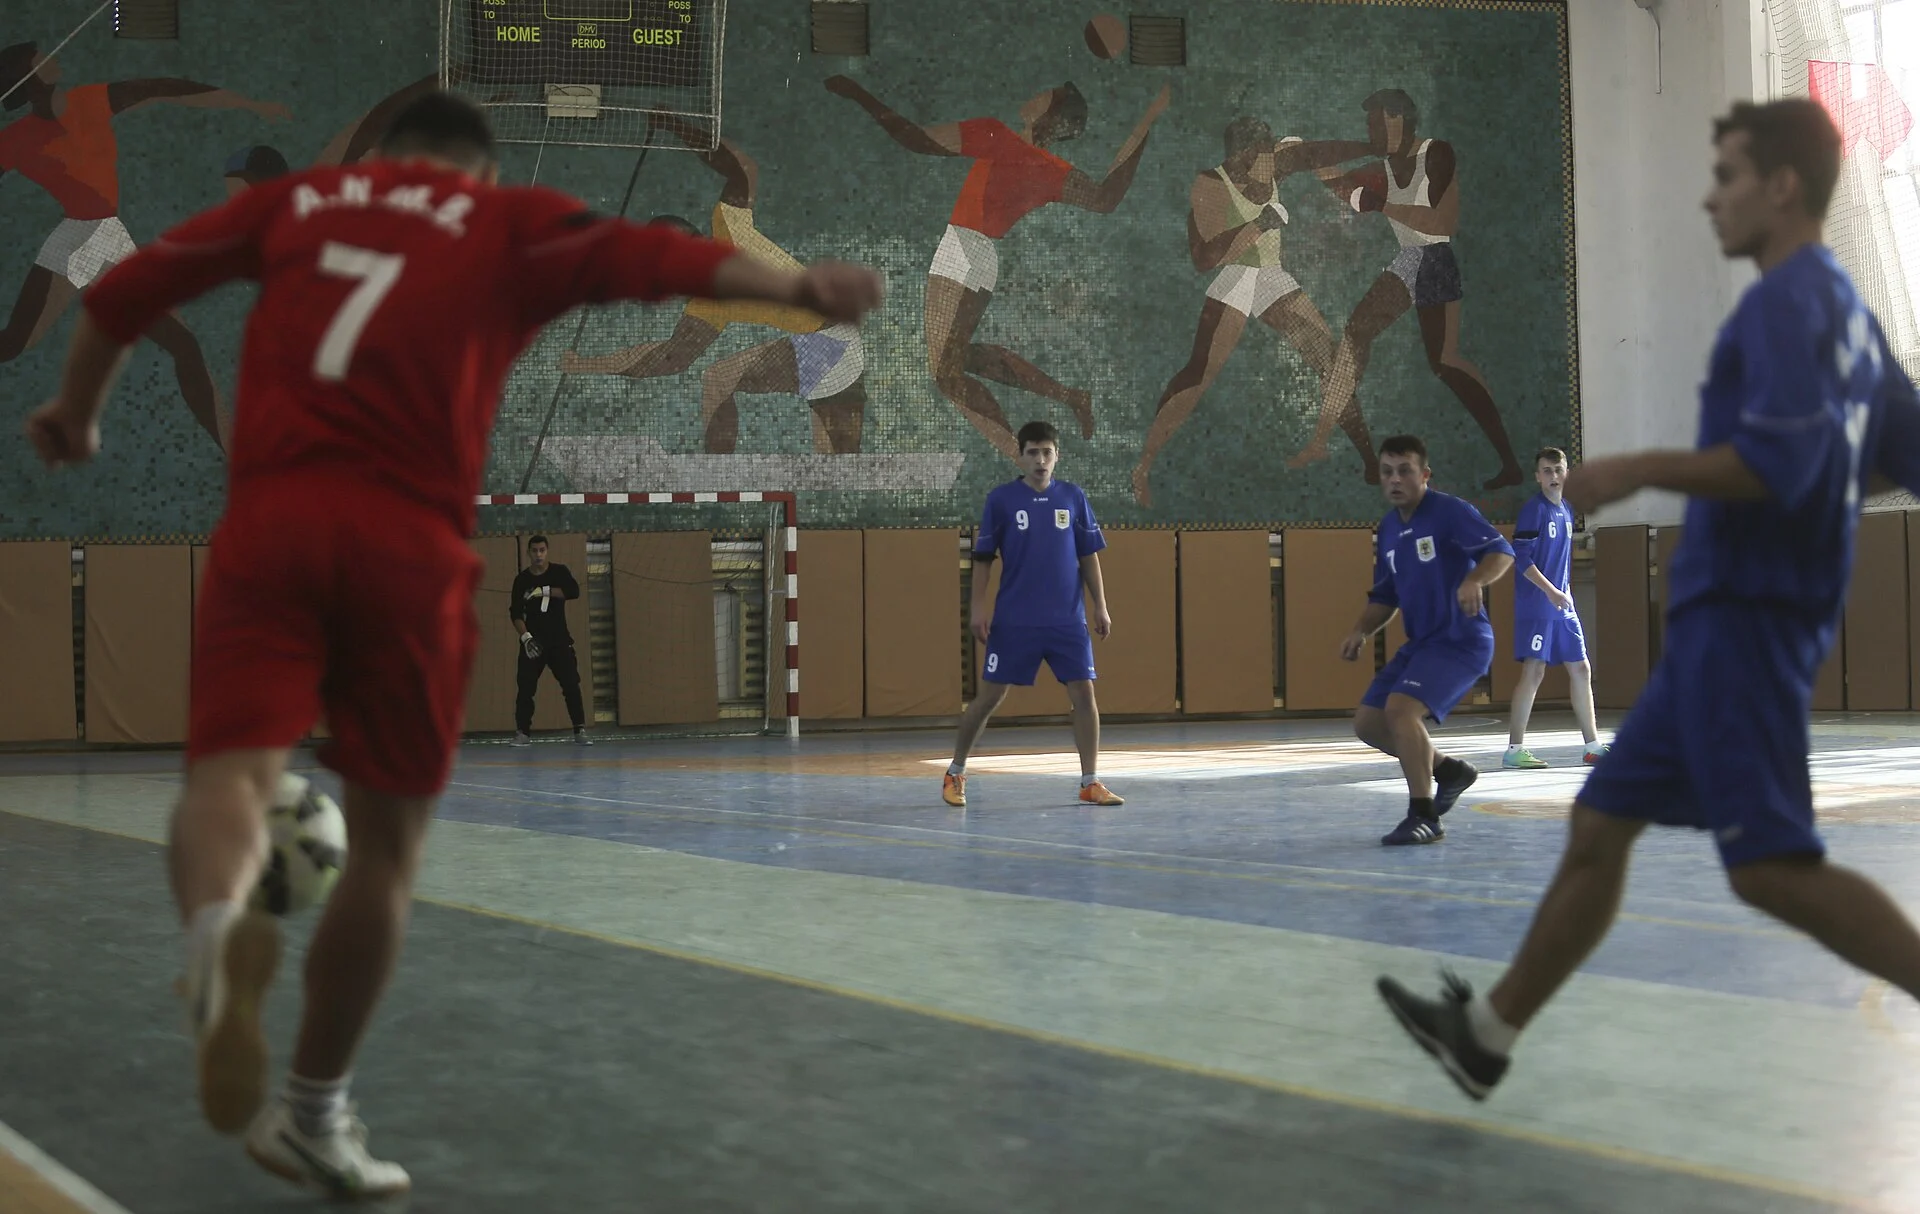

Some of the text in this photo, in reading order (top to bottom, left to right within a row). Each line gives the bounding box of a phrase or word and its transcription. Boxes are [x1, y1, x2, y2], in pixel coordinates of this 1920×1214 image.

[668, 1, 691, 10] POSS
[483, 10, 496, 19] TO
[679, 14, 691, 23] TO
[497, 26, 541, 42] HOME
[633, 28, 683, 45] GUEST
[571, 38, 606, 49] PERIOD
[313, 240, 407, 384] 7
[1016, 509, 1030, 531] 9
[1548, 520, 1557, 539] 6
[1386, 549, 1397, 574] 7
[1531, 634, 1544, 652] 6
[987, 652, 999, 673] 9
